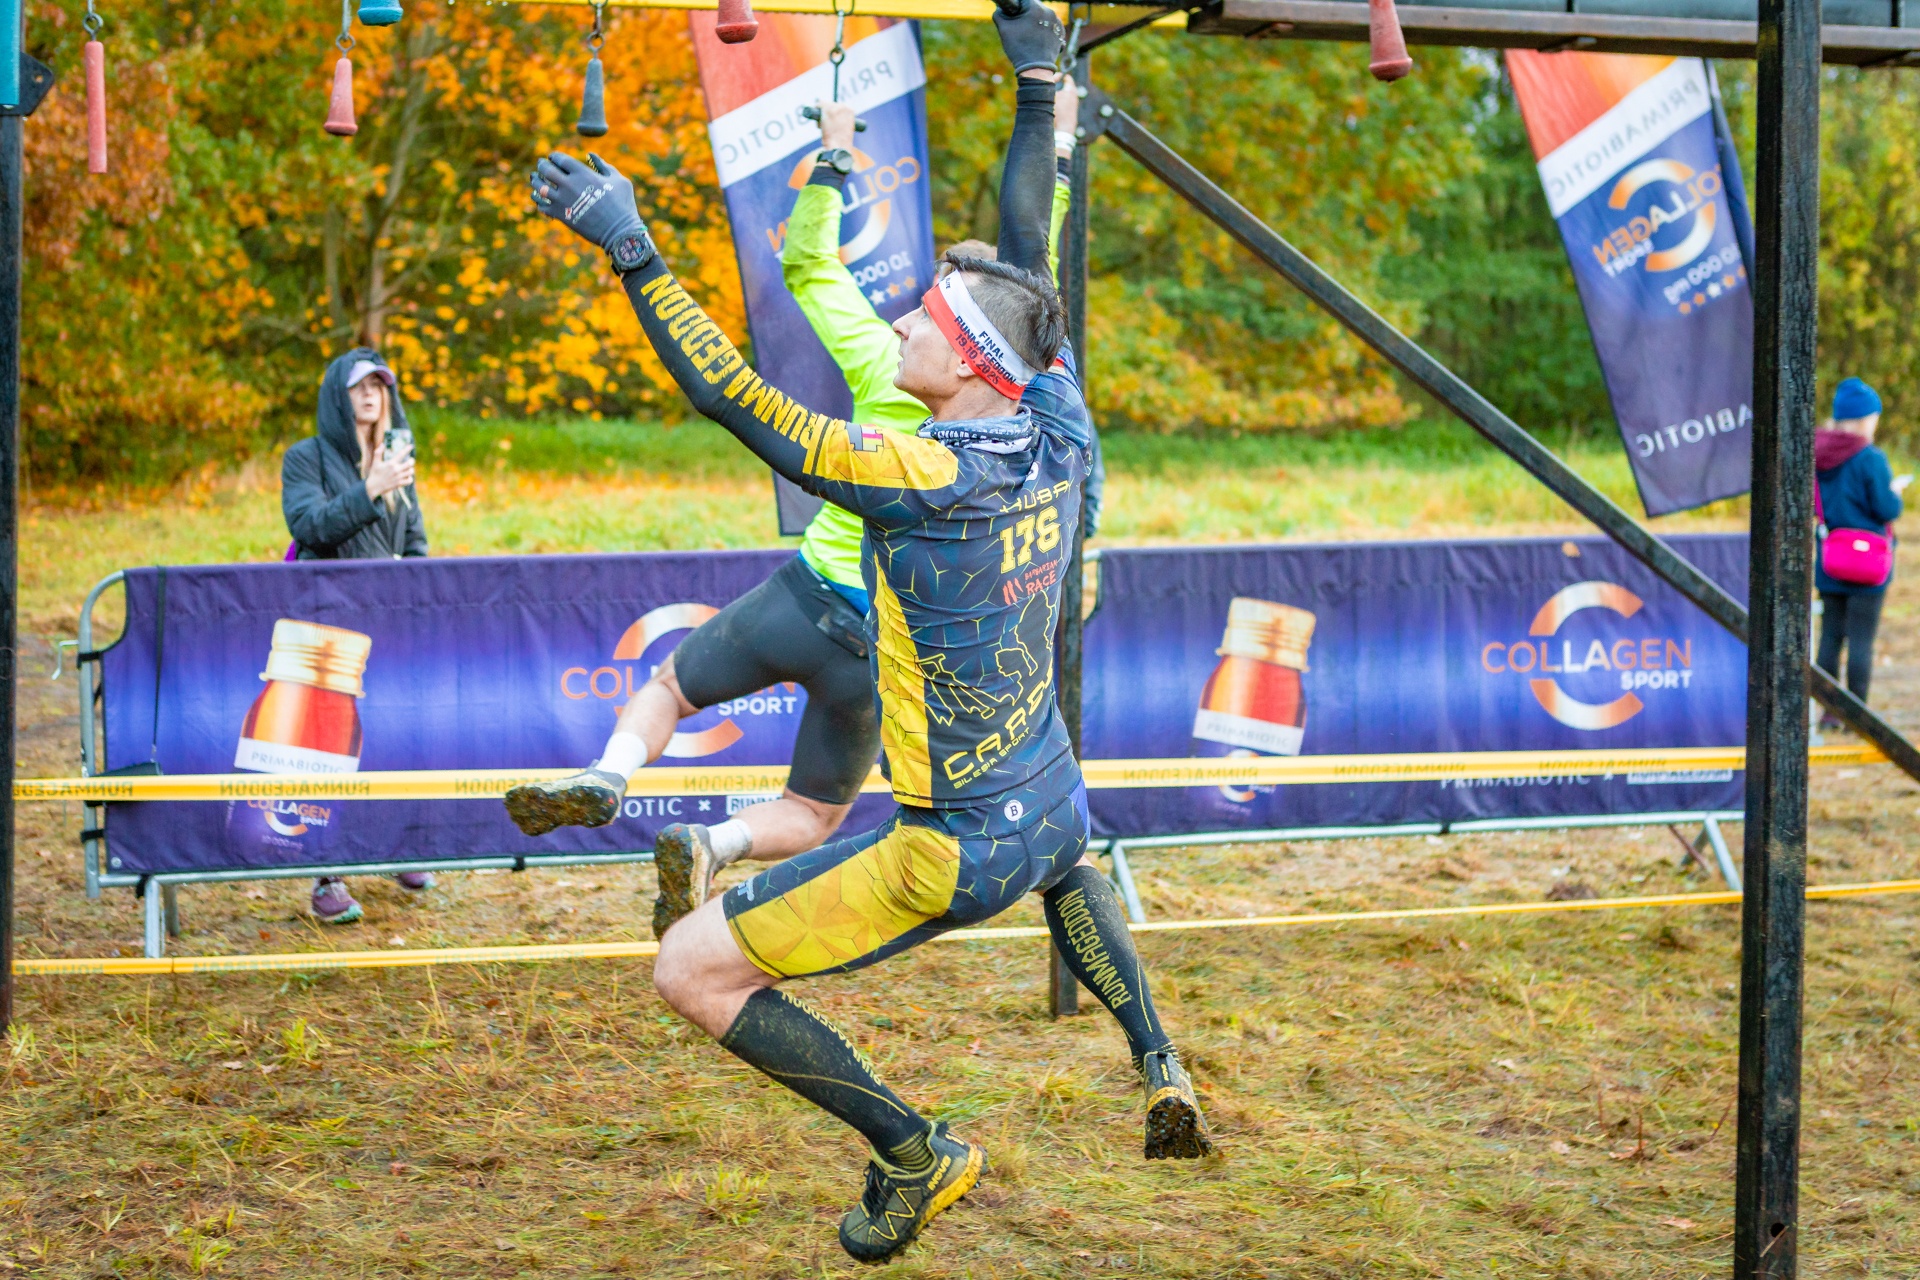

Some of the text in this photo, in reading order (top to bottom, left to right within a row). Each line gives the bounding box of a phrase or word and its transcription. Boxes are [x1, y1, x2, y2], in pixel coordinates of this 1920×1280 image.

[953, 315, 1017, 385] RUNMAGEDDON
[1000, 505, 1062, 574] 176
[1025, 572, 1057, 596] RACE
[1481, 638, 1692, 674] COLLAGEN
[1621, 668, 1693, 691] SPORT
[717, 696, 798, 717] SPORT
[953, 726, 1030, 790] SILESIA SPORT
[1055, 886, 1134, 1011] RUNMAGEDDON
